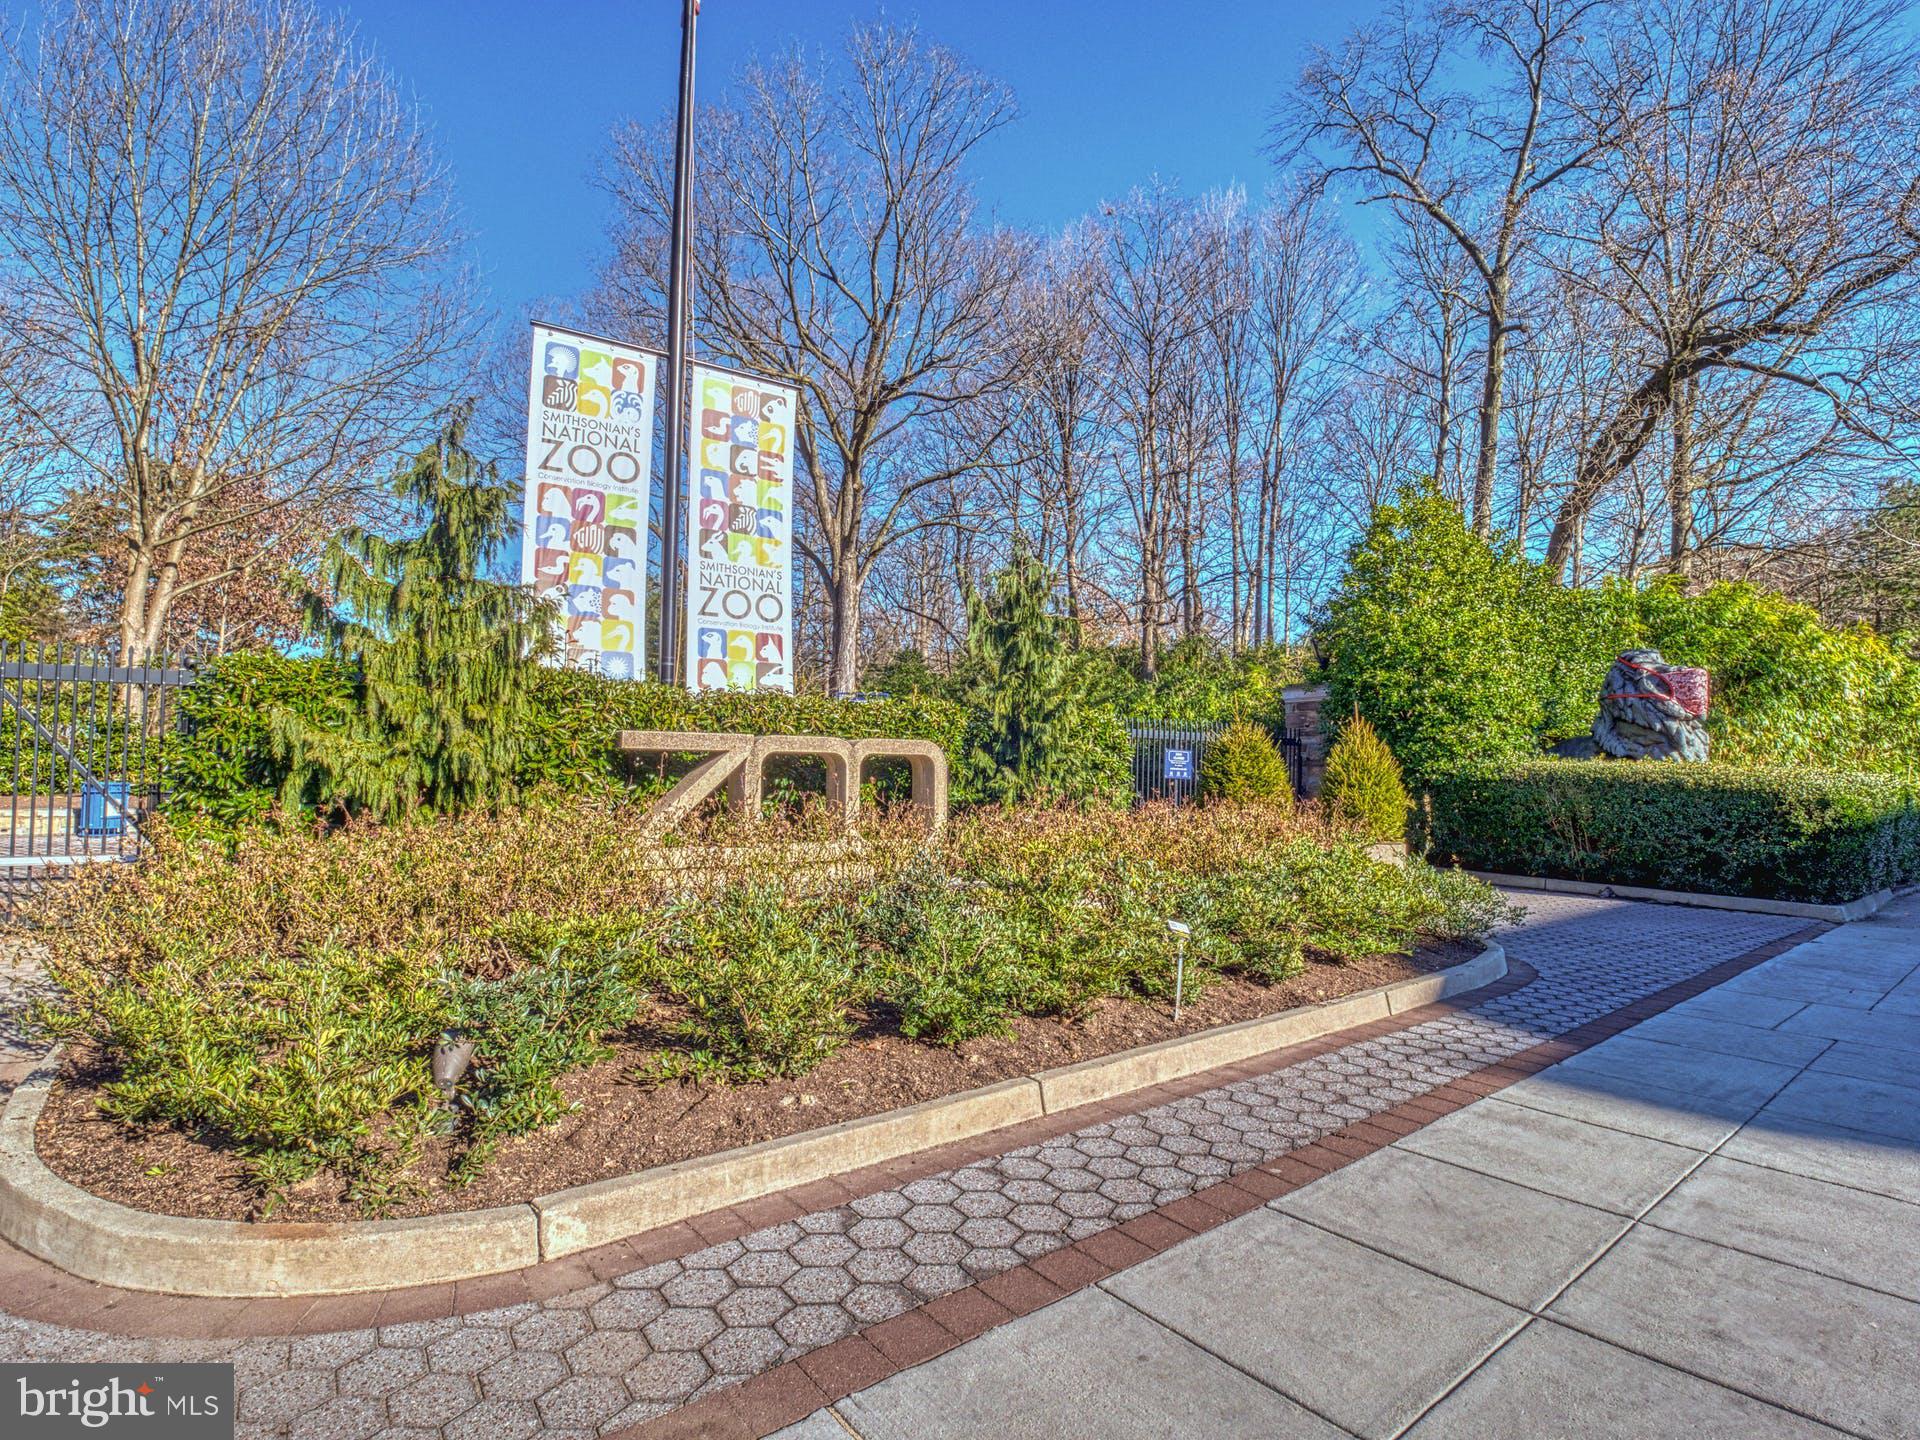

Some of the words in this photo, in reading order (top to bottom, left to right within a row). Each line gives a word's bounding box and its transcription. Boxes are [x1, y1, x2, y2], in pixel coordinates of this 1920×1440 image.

[542, 410, 640, 439] SMITHSONIAN'S
[542, 421, 640, 454] NATIONAL
[538, 437, 640, 484] ZOO
[538, 471, 585, 485] Conservation
[699, 560, 783, 580] SMITHSONIAN'S
[699, 571, 783, 595] NATIONAL
[697, 586, 783, 623] ZOO
